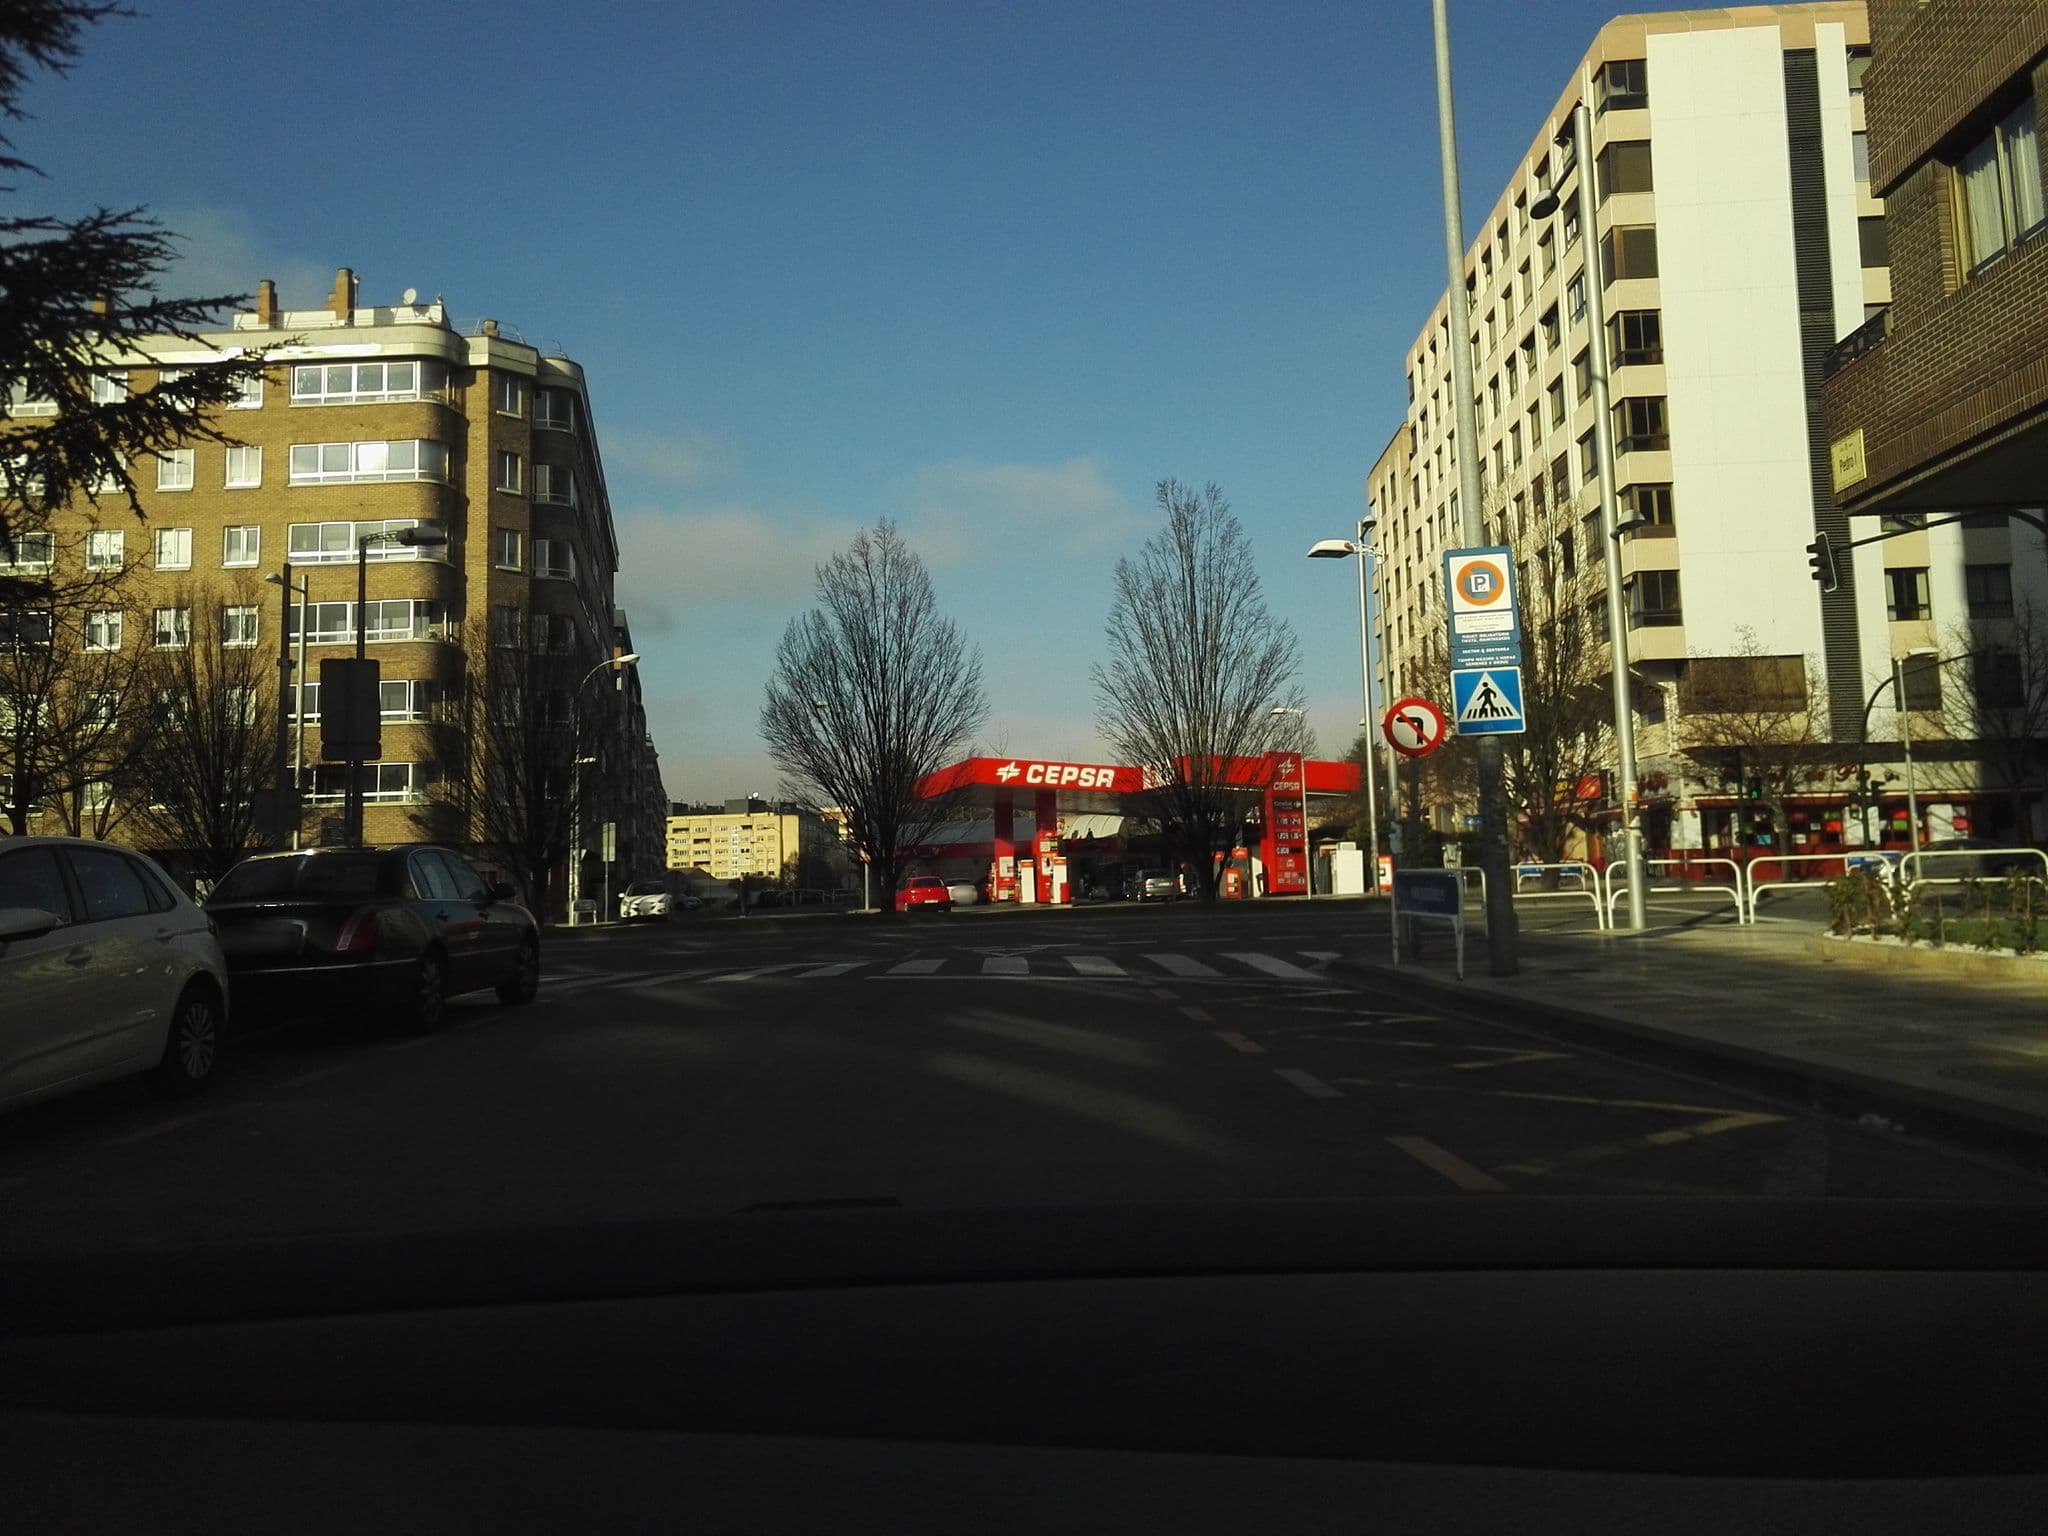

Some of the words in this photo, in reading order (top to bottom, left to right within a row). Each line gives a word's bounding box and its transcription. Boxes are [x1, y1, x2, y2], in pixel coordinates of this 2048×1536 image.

[1474, 576, 1486, 591] P
[1026, 764, 1115, 788] CEPSA
[1273, 781, 1300, 791] CEPSA
